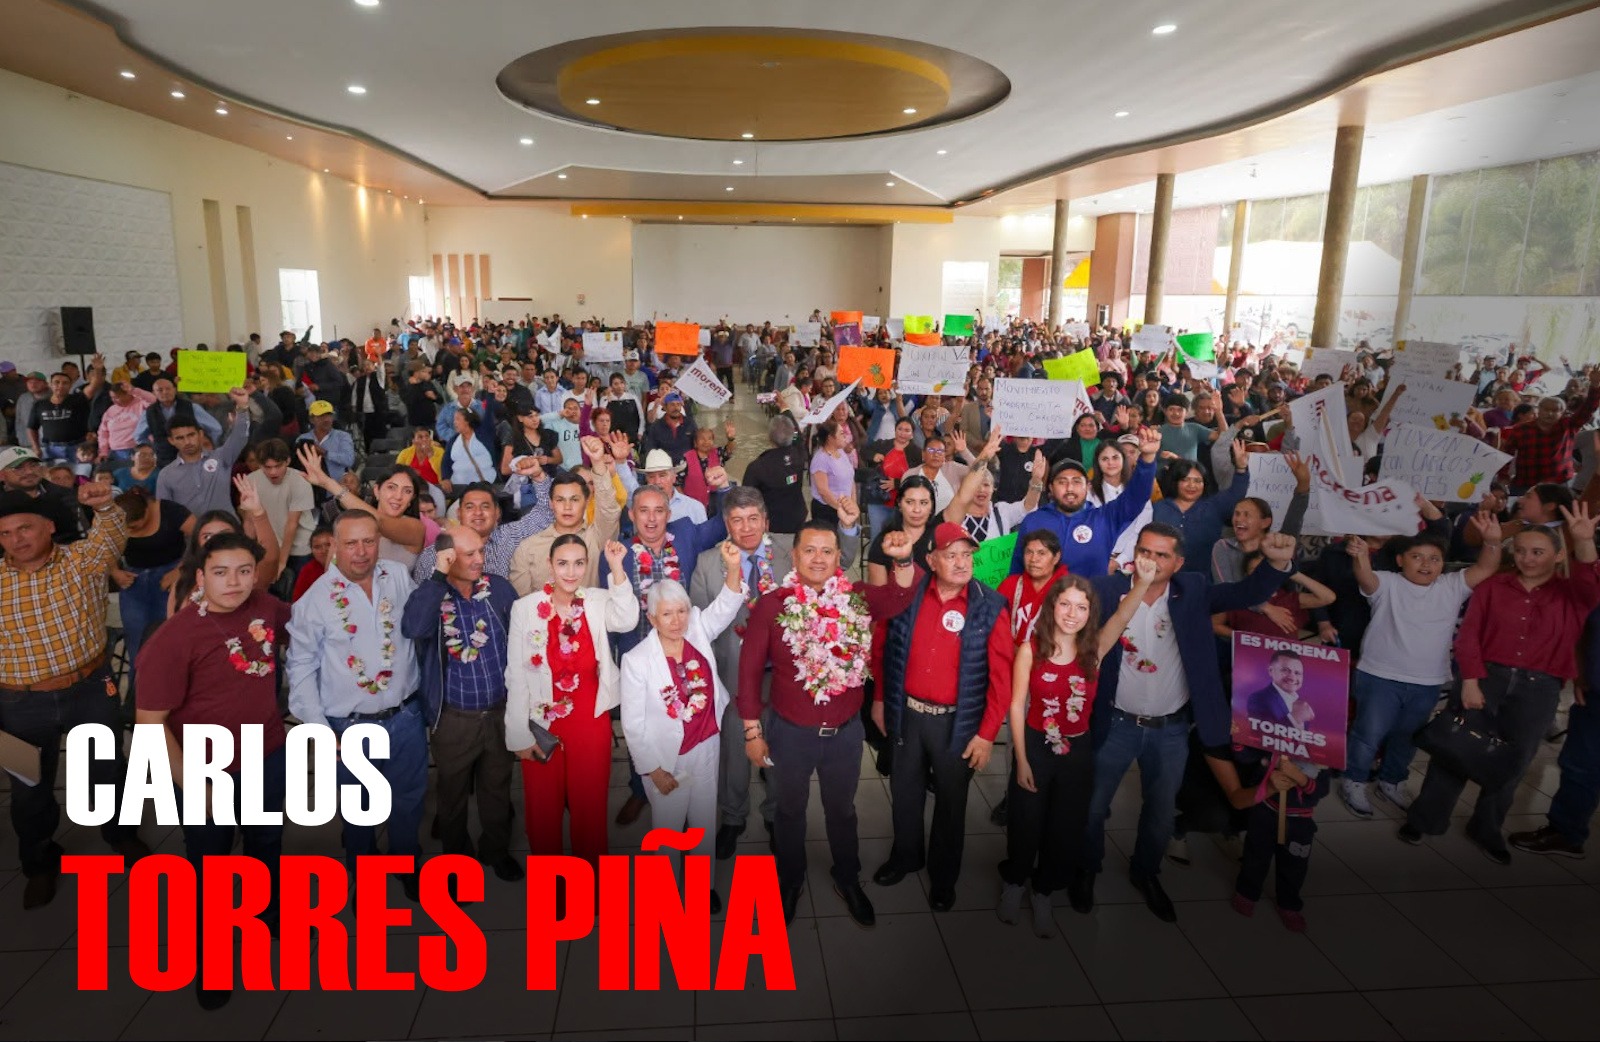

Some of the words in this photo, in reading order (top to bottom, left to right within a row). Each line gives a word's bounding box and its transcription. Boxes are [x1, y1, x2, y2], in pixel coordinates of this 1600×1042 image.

[690, 367, 728, 398] morena
[1240, 634, 1261, 648] ES
[1264, 638, 1341, 663] MORENA
[1248, 717, 1327, 747] TORRES
